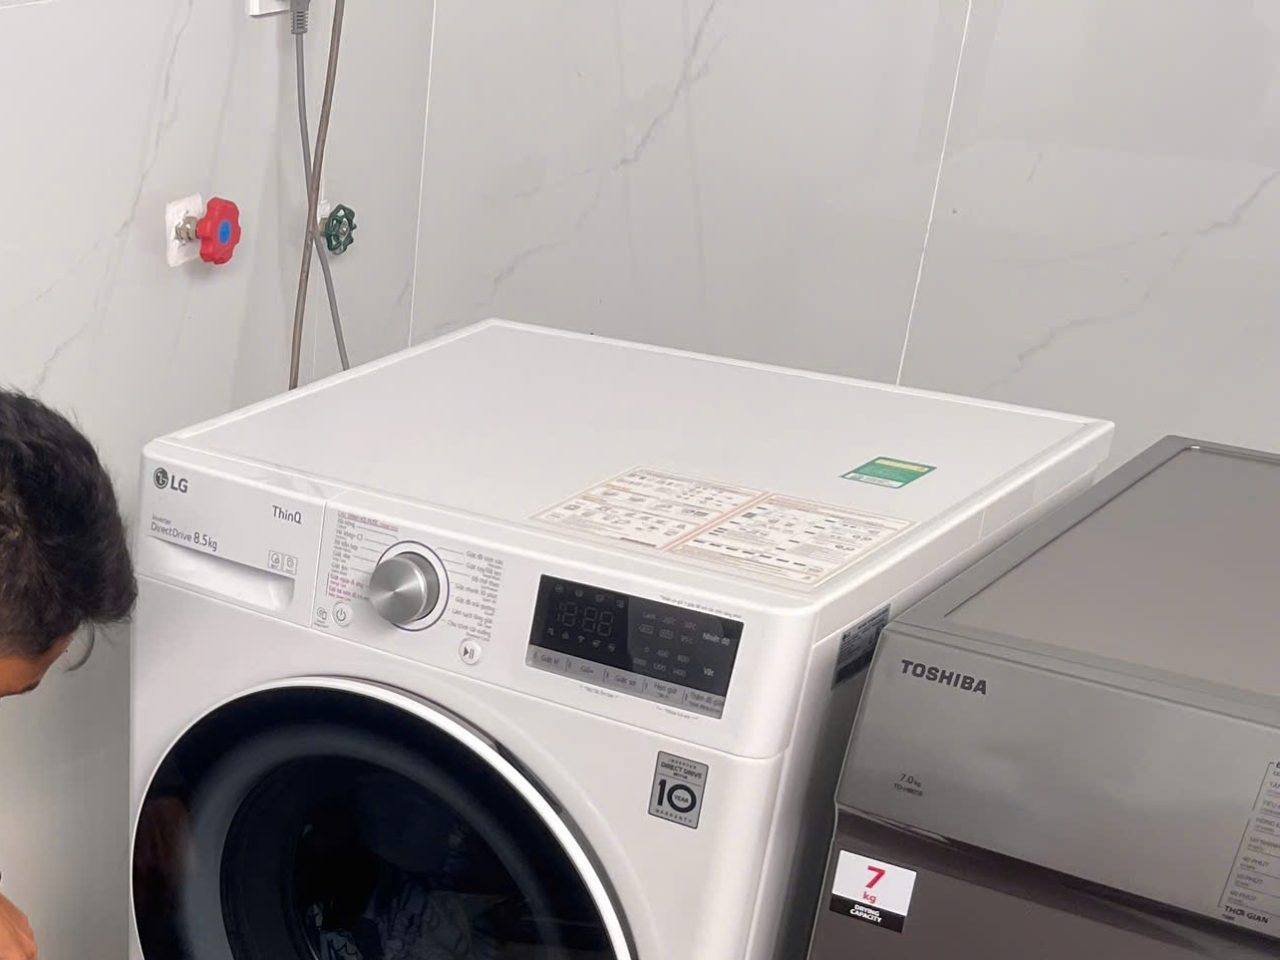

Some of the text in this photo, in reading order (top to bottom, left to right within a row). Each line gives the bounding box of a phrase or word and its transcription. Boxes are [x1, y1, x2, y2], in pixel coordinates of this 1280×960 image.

[170, 474, 189, 494] LG
[272, 504, 302, 525] ThinQ
[901, 659, 987, 695] TOSHIBA
[657, 779, 698, 814] 10
[865, 864, 887, 889] 7
[862, 890, 878, 905] kg
[849, 908, 883, 923] CAPACITY
[854, 903, 881, 917] DRYING
